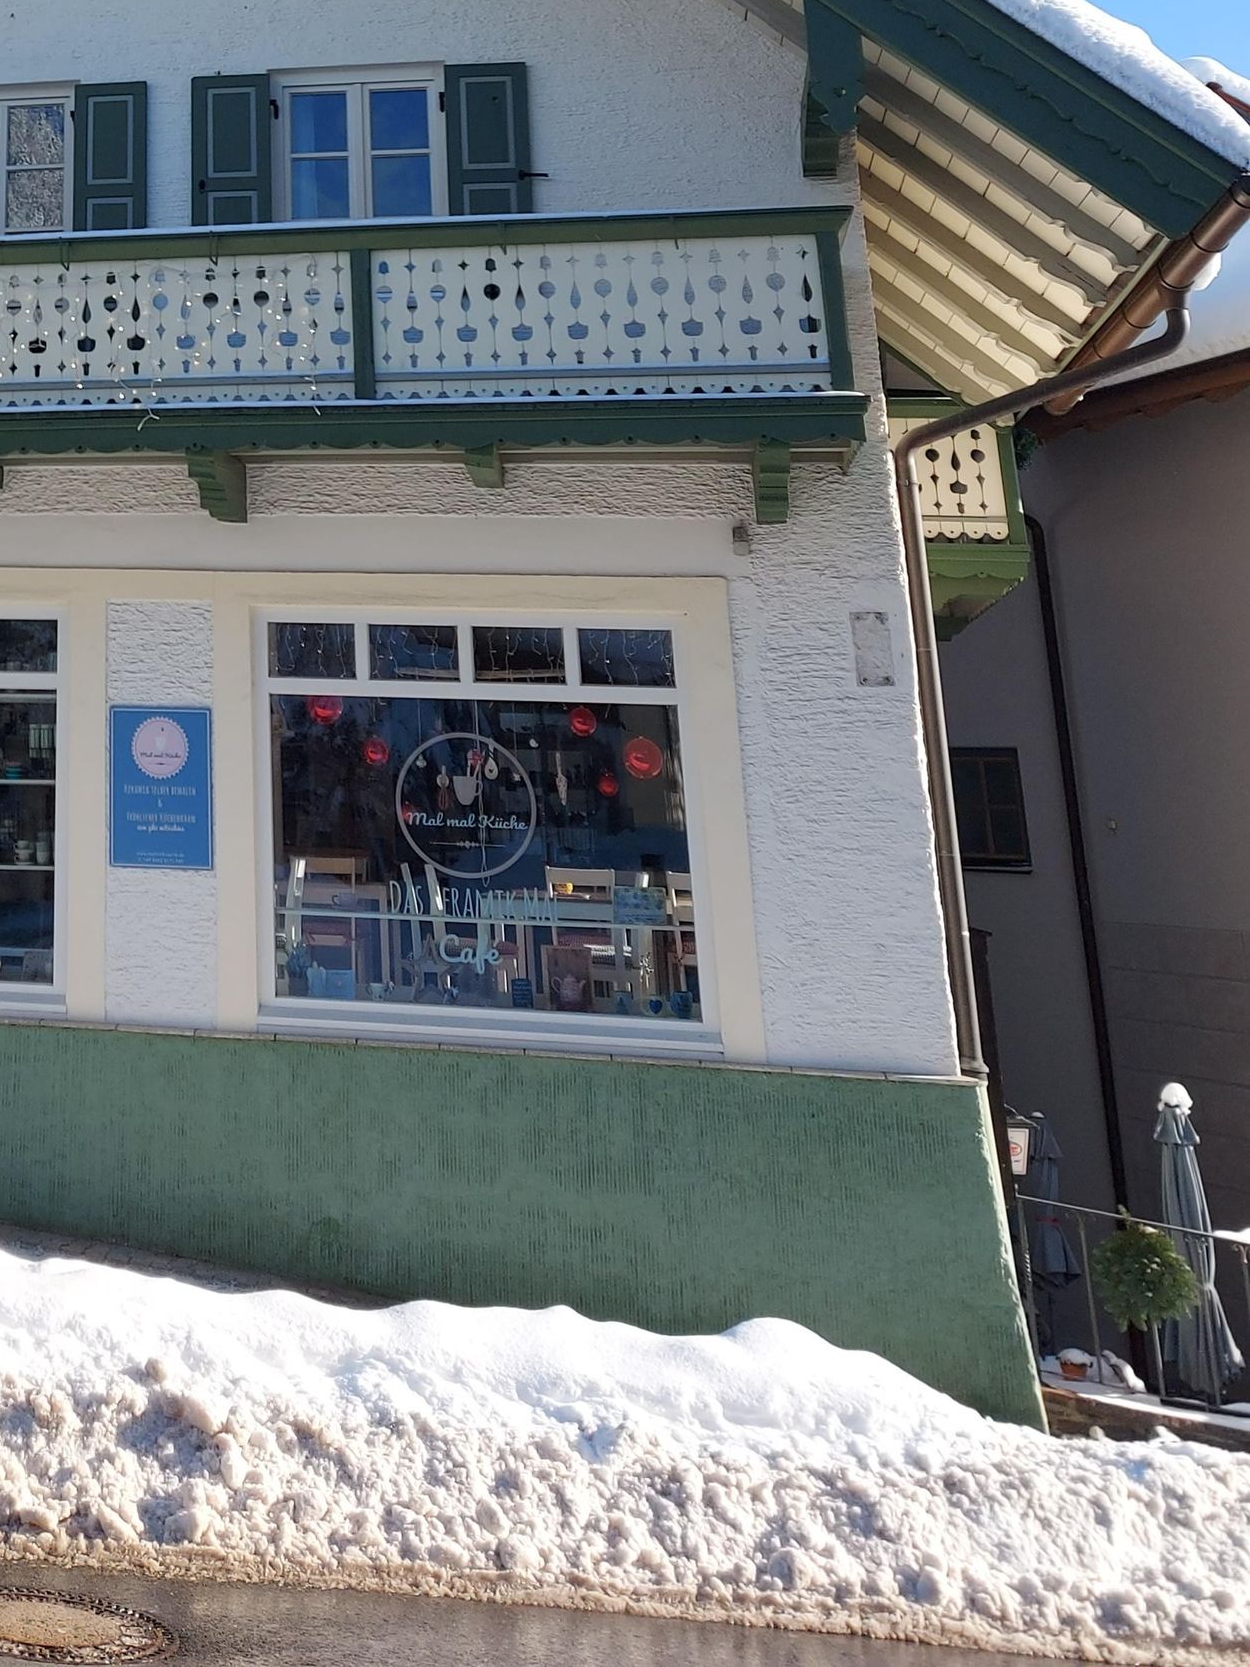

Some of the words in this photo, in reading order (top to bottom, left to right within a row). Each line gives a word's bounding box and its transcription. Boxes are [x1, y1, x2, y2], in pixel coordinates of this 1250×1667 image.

[406, 812, 444, 827] Mal
[447, 814, 476, 828] mal
[478, 814, 528, 830] Küche
[389, 880, 424, 915] DAS
[432, 885, 517, 921] ERAMIK
[439, 934, 503, 974] Café
